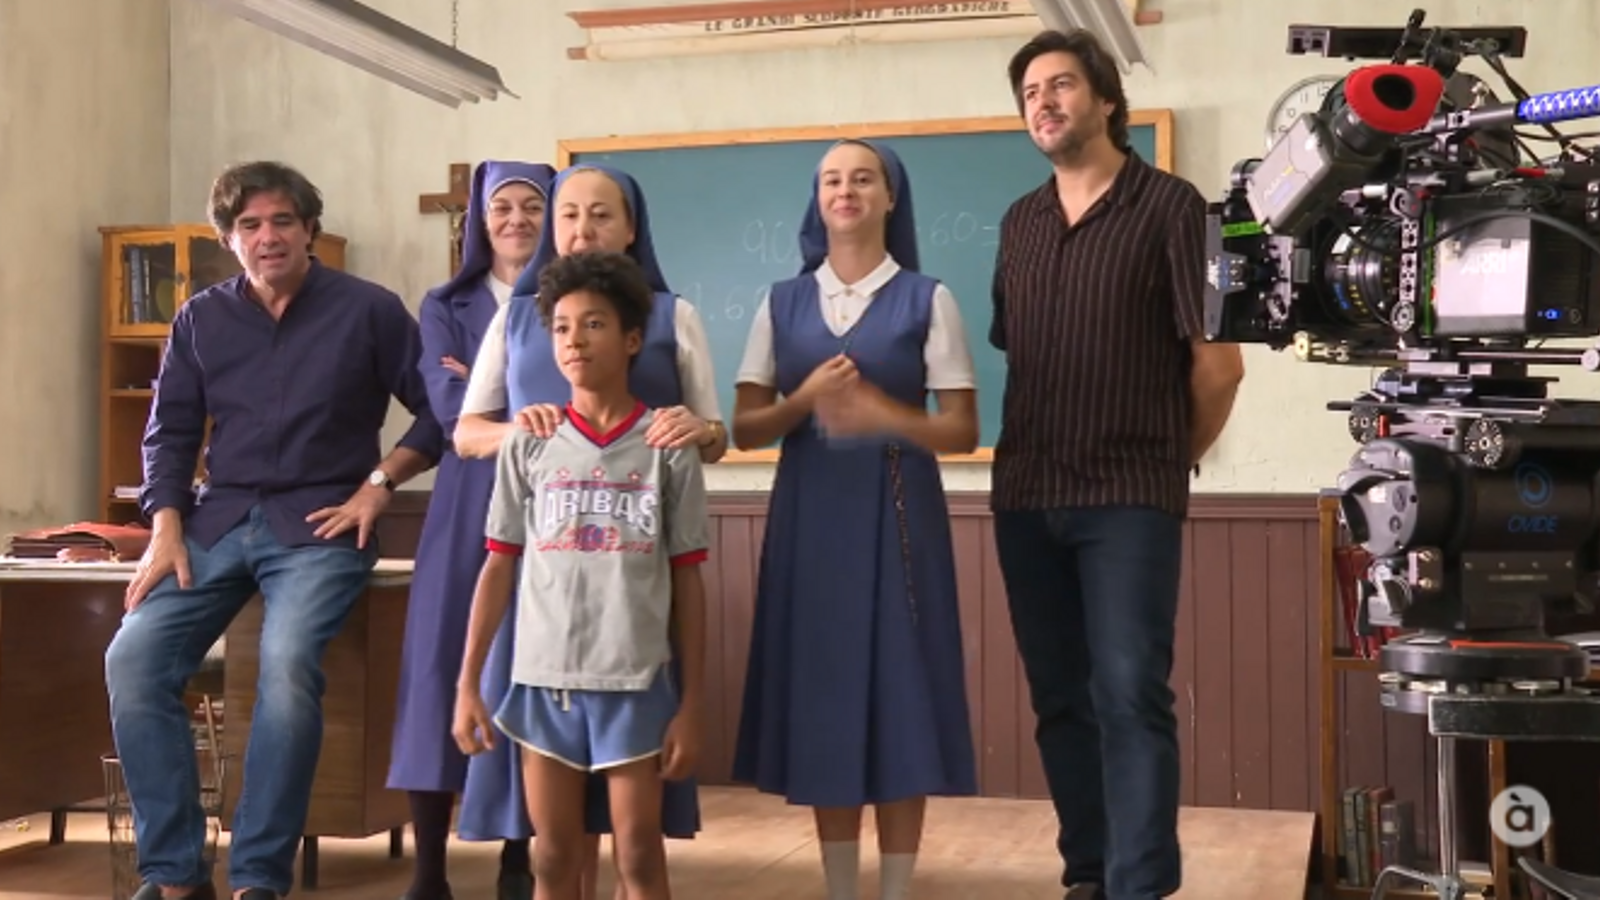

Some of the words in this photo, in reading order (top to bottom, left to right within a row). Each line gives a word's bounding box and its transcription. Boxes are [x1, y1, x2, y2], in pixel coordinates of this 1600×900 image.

[705, 21, 723, 32] LE
[732, 14, 795, 29] GRANDI
[1459, 251, 1507, 276] ARRI
[524, 487, 659, 537] ARIBAS
[1507, 514, 1558, 533] OVIDE
